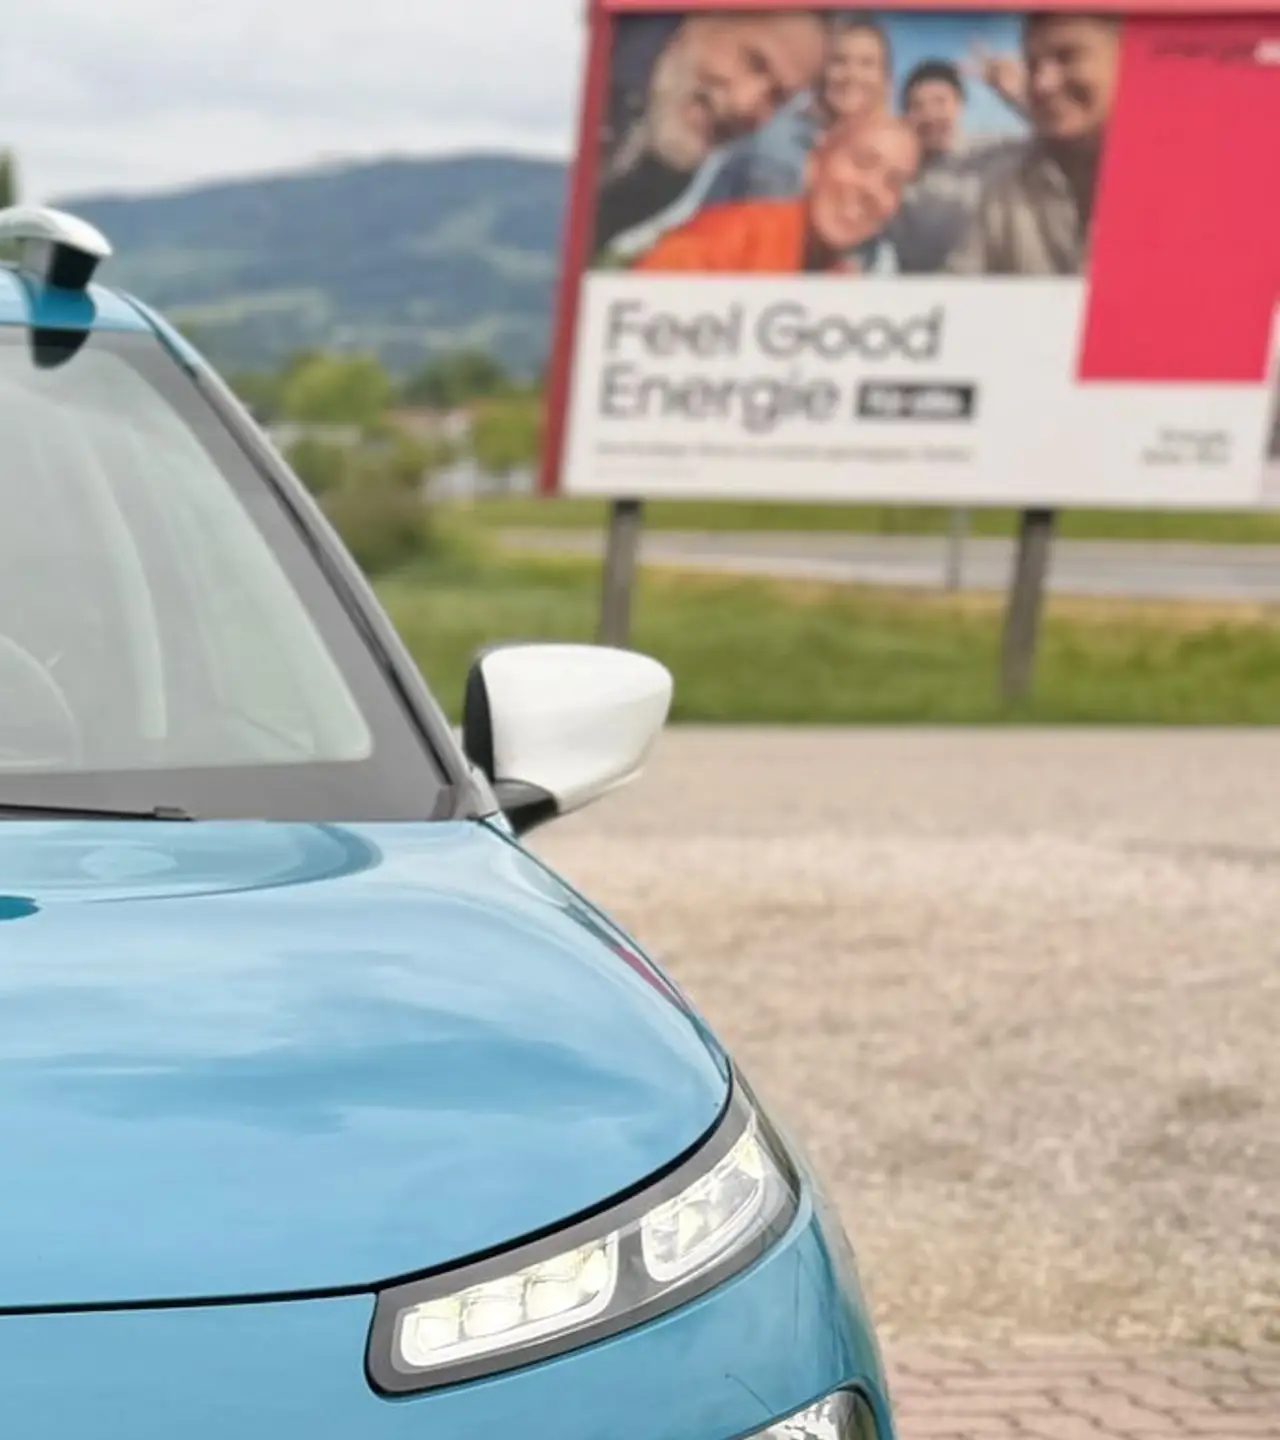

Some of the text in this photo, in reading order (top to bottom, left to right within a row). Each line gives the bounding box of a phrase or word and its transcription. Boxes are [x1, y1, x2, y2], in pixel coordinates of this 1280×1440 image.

[605, 298, 944, 359] Feel Good
[598, 363, 841, 433] Energie
